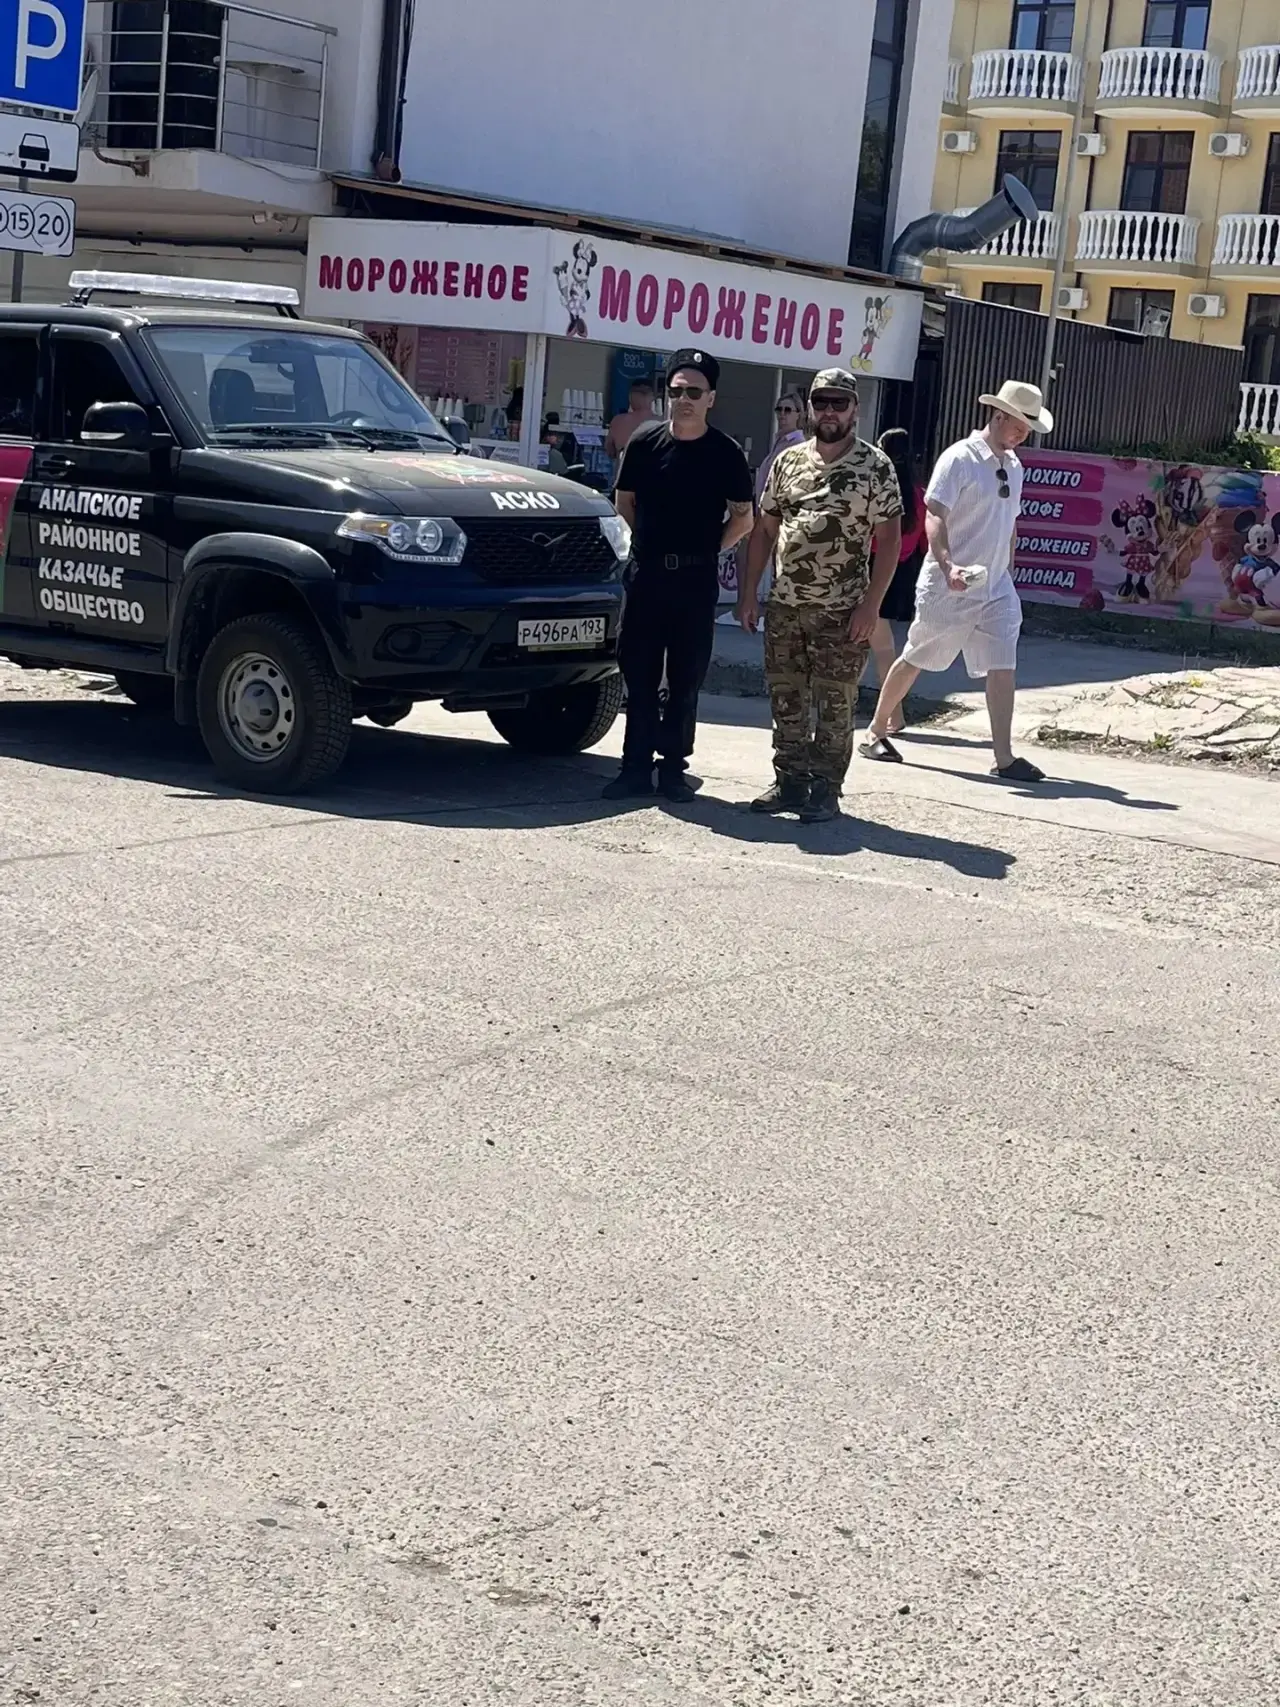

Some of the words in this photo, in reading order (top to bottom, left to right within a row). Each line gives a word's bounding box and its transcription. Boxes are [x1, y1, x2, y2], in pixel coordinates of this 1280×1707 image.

[15, 0, 66, 88] P
[11, 211, 29, 231] 15
[38, 213, 64, 236] 20
[319, 255, 529, 301] МОРОЖЕНОЕ
[599, 266, 844, 355] МОРОЖЕНОЕ
[38, 488, 143, 520] АНАПСКОЕ
[490, 491, 561, 511] АСКО
[39, 518, 141, 556] РАЙОННОЕ
[1015, 537, 1090, 555] ОРОЖЕНОЕ
[38, 557, 124, 589] КАЗАЧЬЕ
[40, 588, 145, 624] ОБЩЕСТВО
[522, 622, 579, 644] Р496РА
[581, 619, 601, 635] 193
